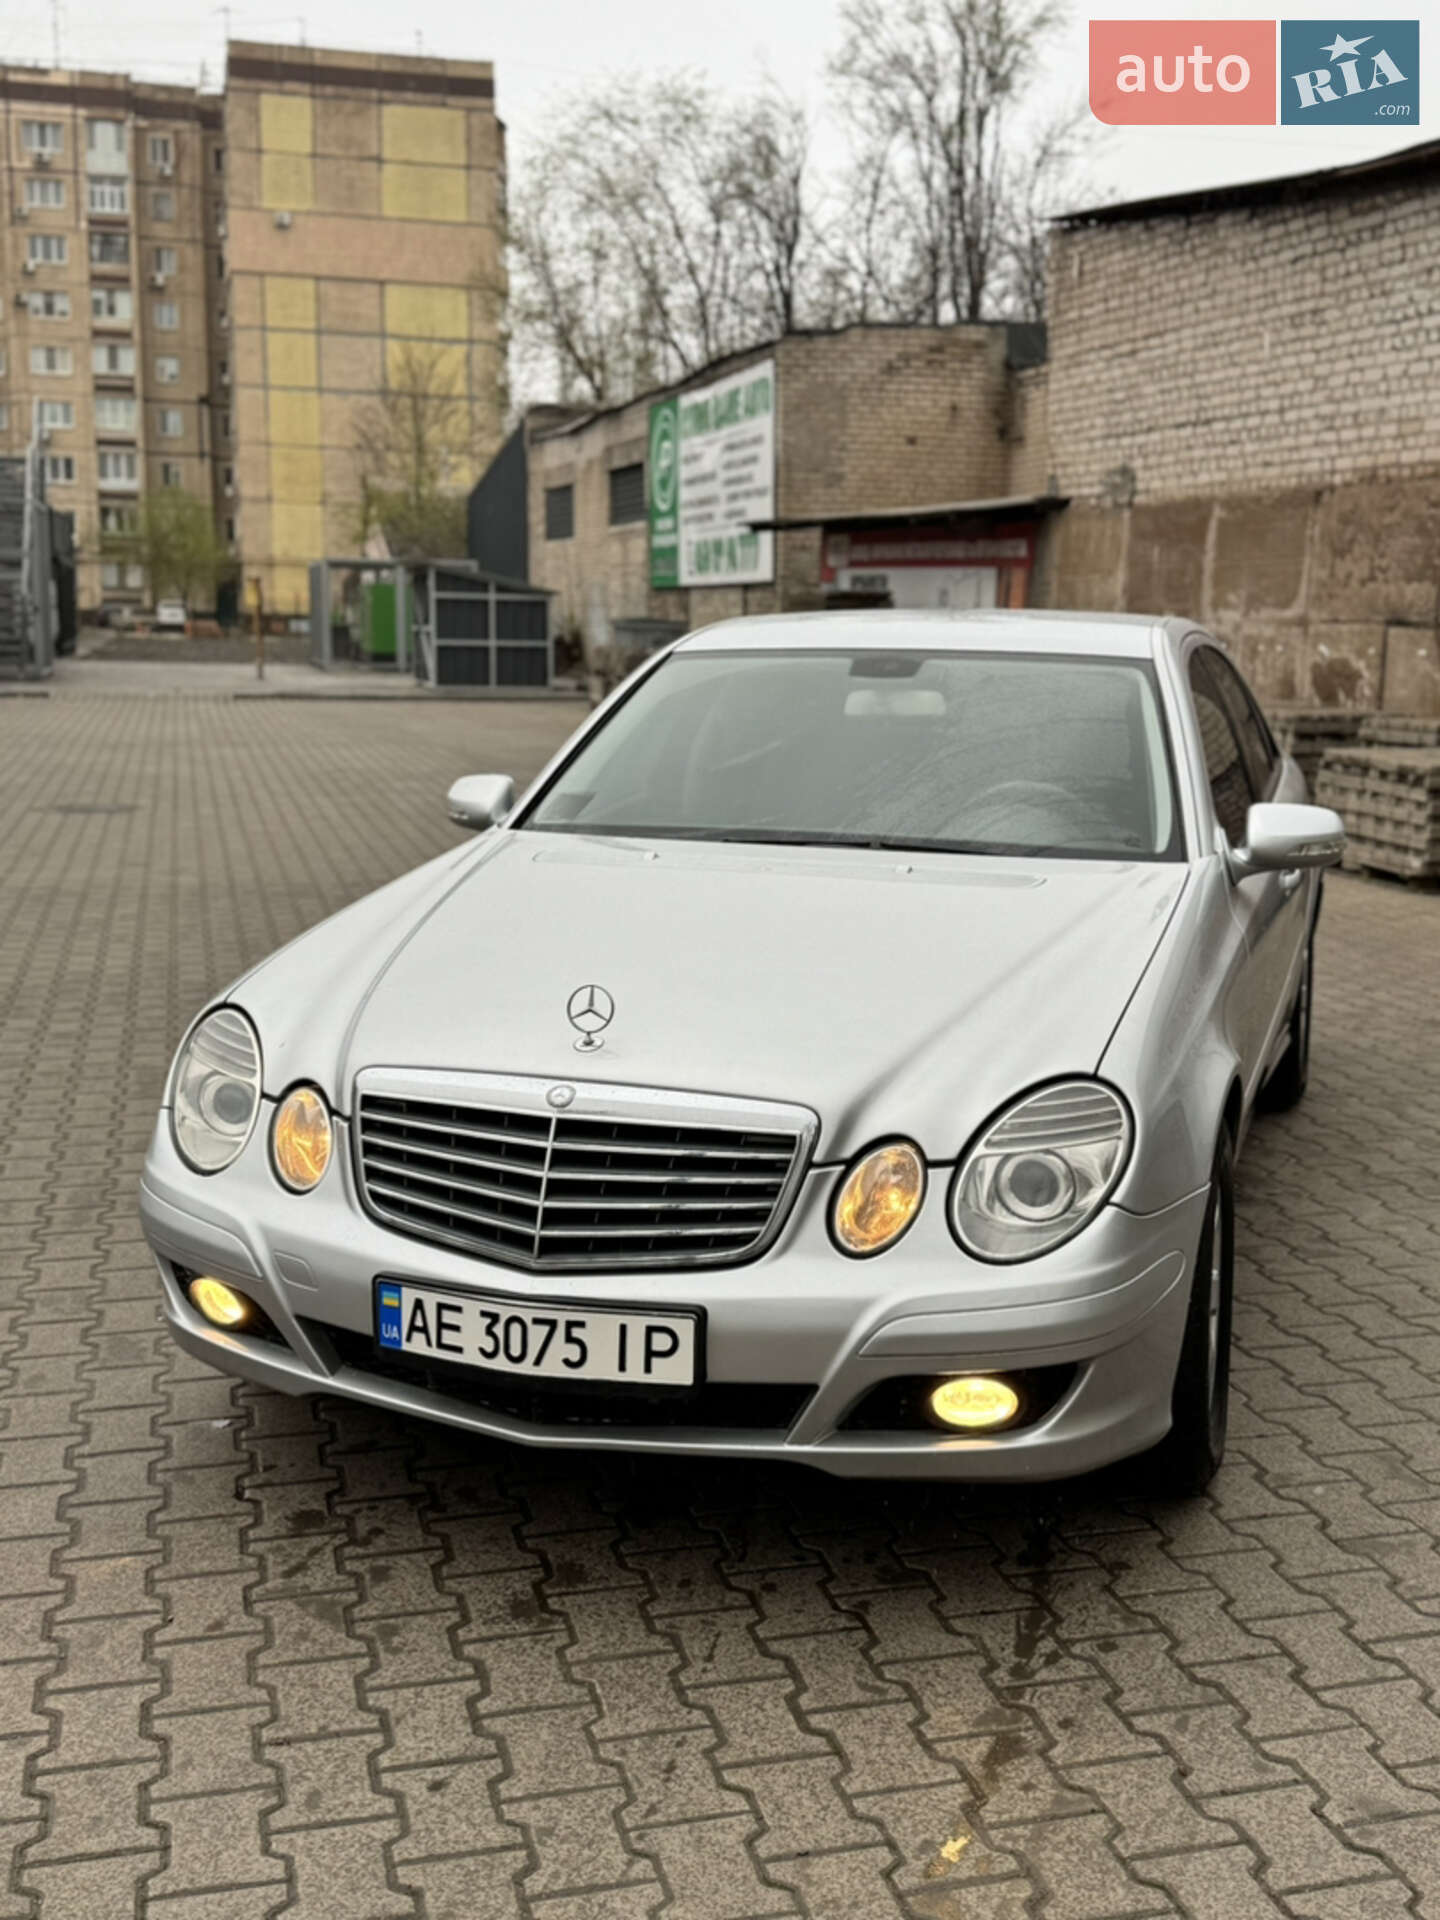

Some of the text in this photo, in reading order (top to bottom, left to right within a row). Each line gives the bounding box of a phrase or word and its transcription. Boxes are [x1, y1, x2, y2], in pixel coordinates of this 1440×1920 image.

[381, 1324, 399, 1340] UA
[405, 1298, 680, 1374] AE 3075 IP
